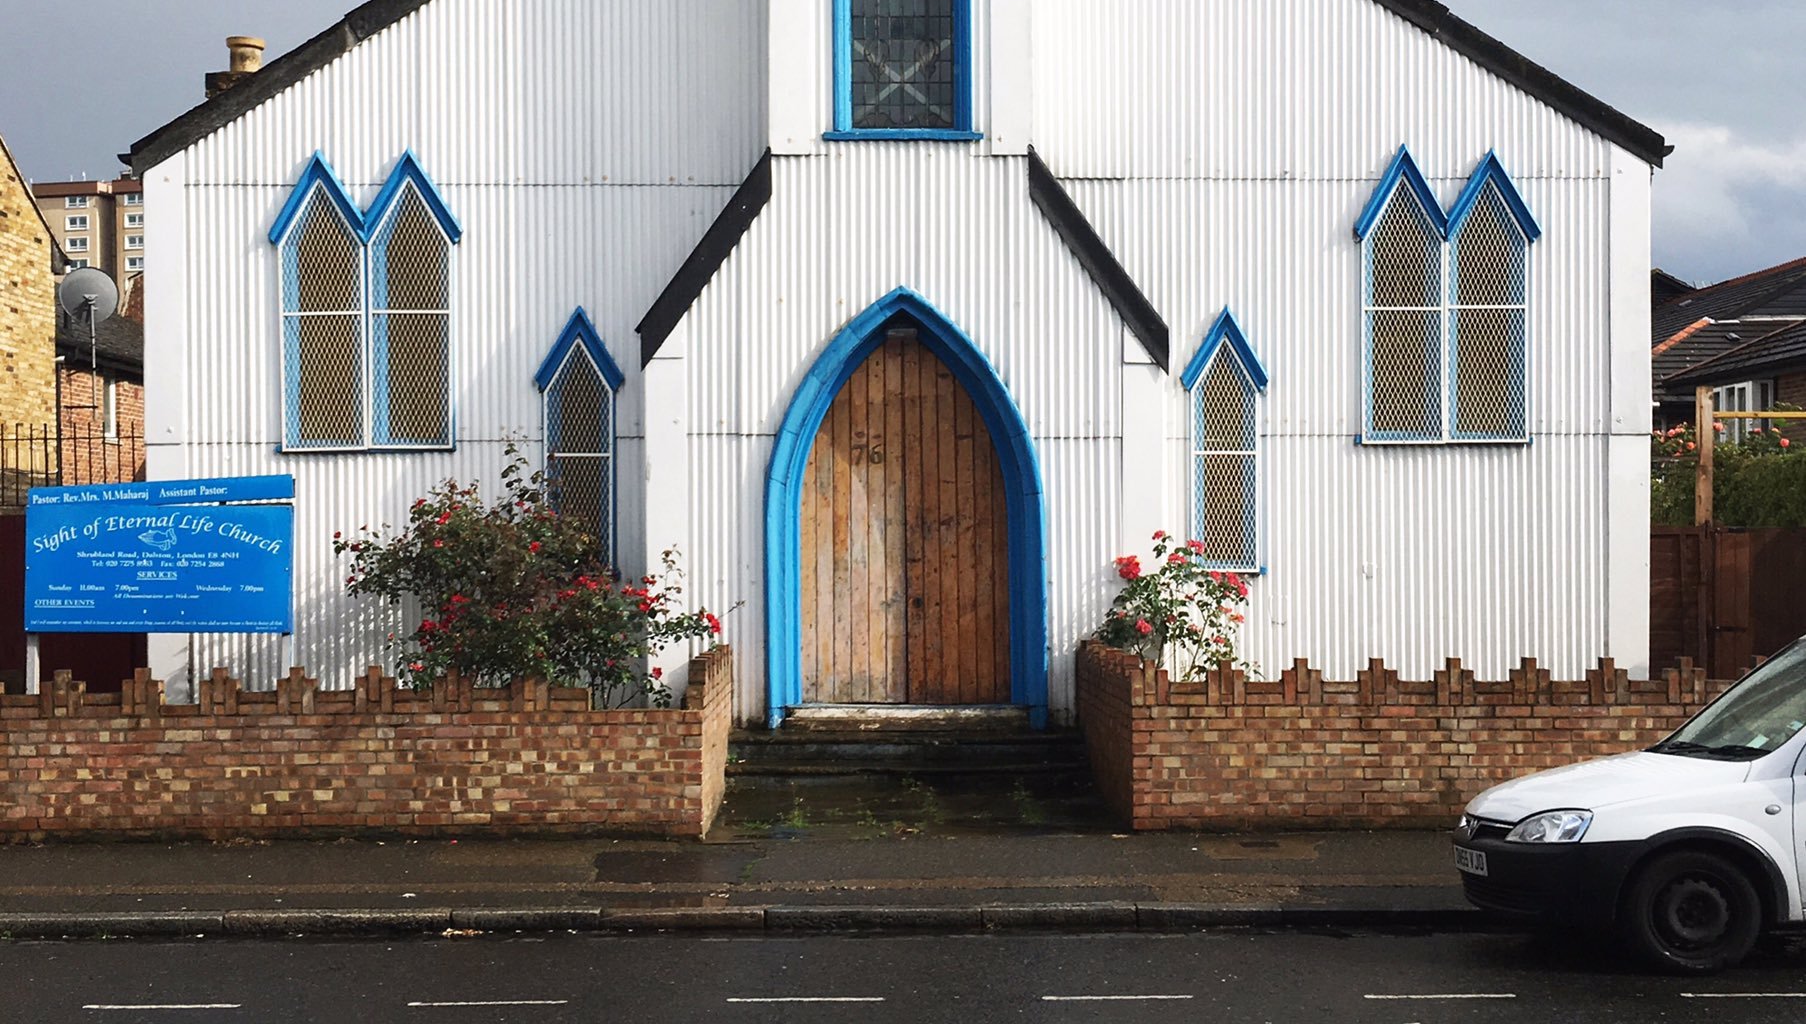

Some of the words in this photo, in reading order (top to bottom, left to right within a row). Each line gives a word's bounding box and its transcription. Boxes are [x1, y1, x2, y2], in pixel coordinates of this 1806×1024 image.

[850, 443, 883, 466] 76
[32, 494, 61, 504] Pastor:
[159, 487, 197, 498] Assistant
[199, 485, 228, 496] Pastor:
[33, 525, 78, 553] Sight
[83, 516, 102, 540] of
[105, 511, 180, 531] Eternal
[178, 514, 214, 535] Life
[218, 522, 283, 555] Church
[117, 551, 140, 559] Road,
[176, 551, 205, 559] London
[136, 570, 178, 578] SERVICES
[48, 584, 72, 592] Sunday
[115, 584, 139, 592] 7.00pm
[195, 584, 232, 592] Wednesday
[239, 584, 264, 593] 7.00pm
